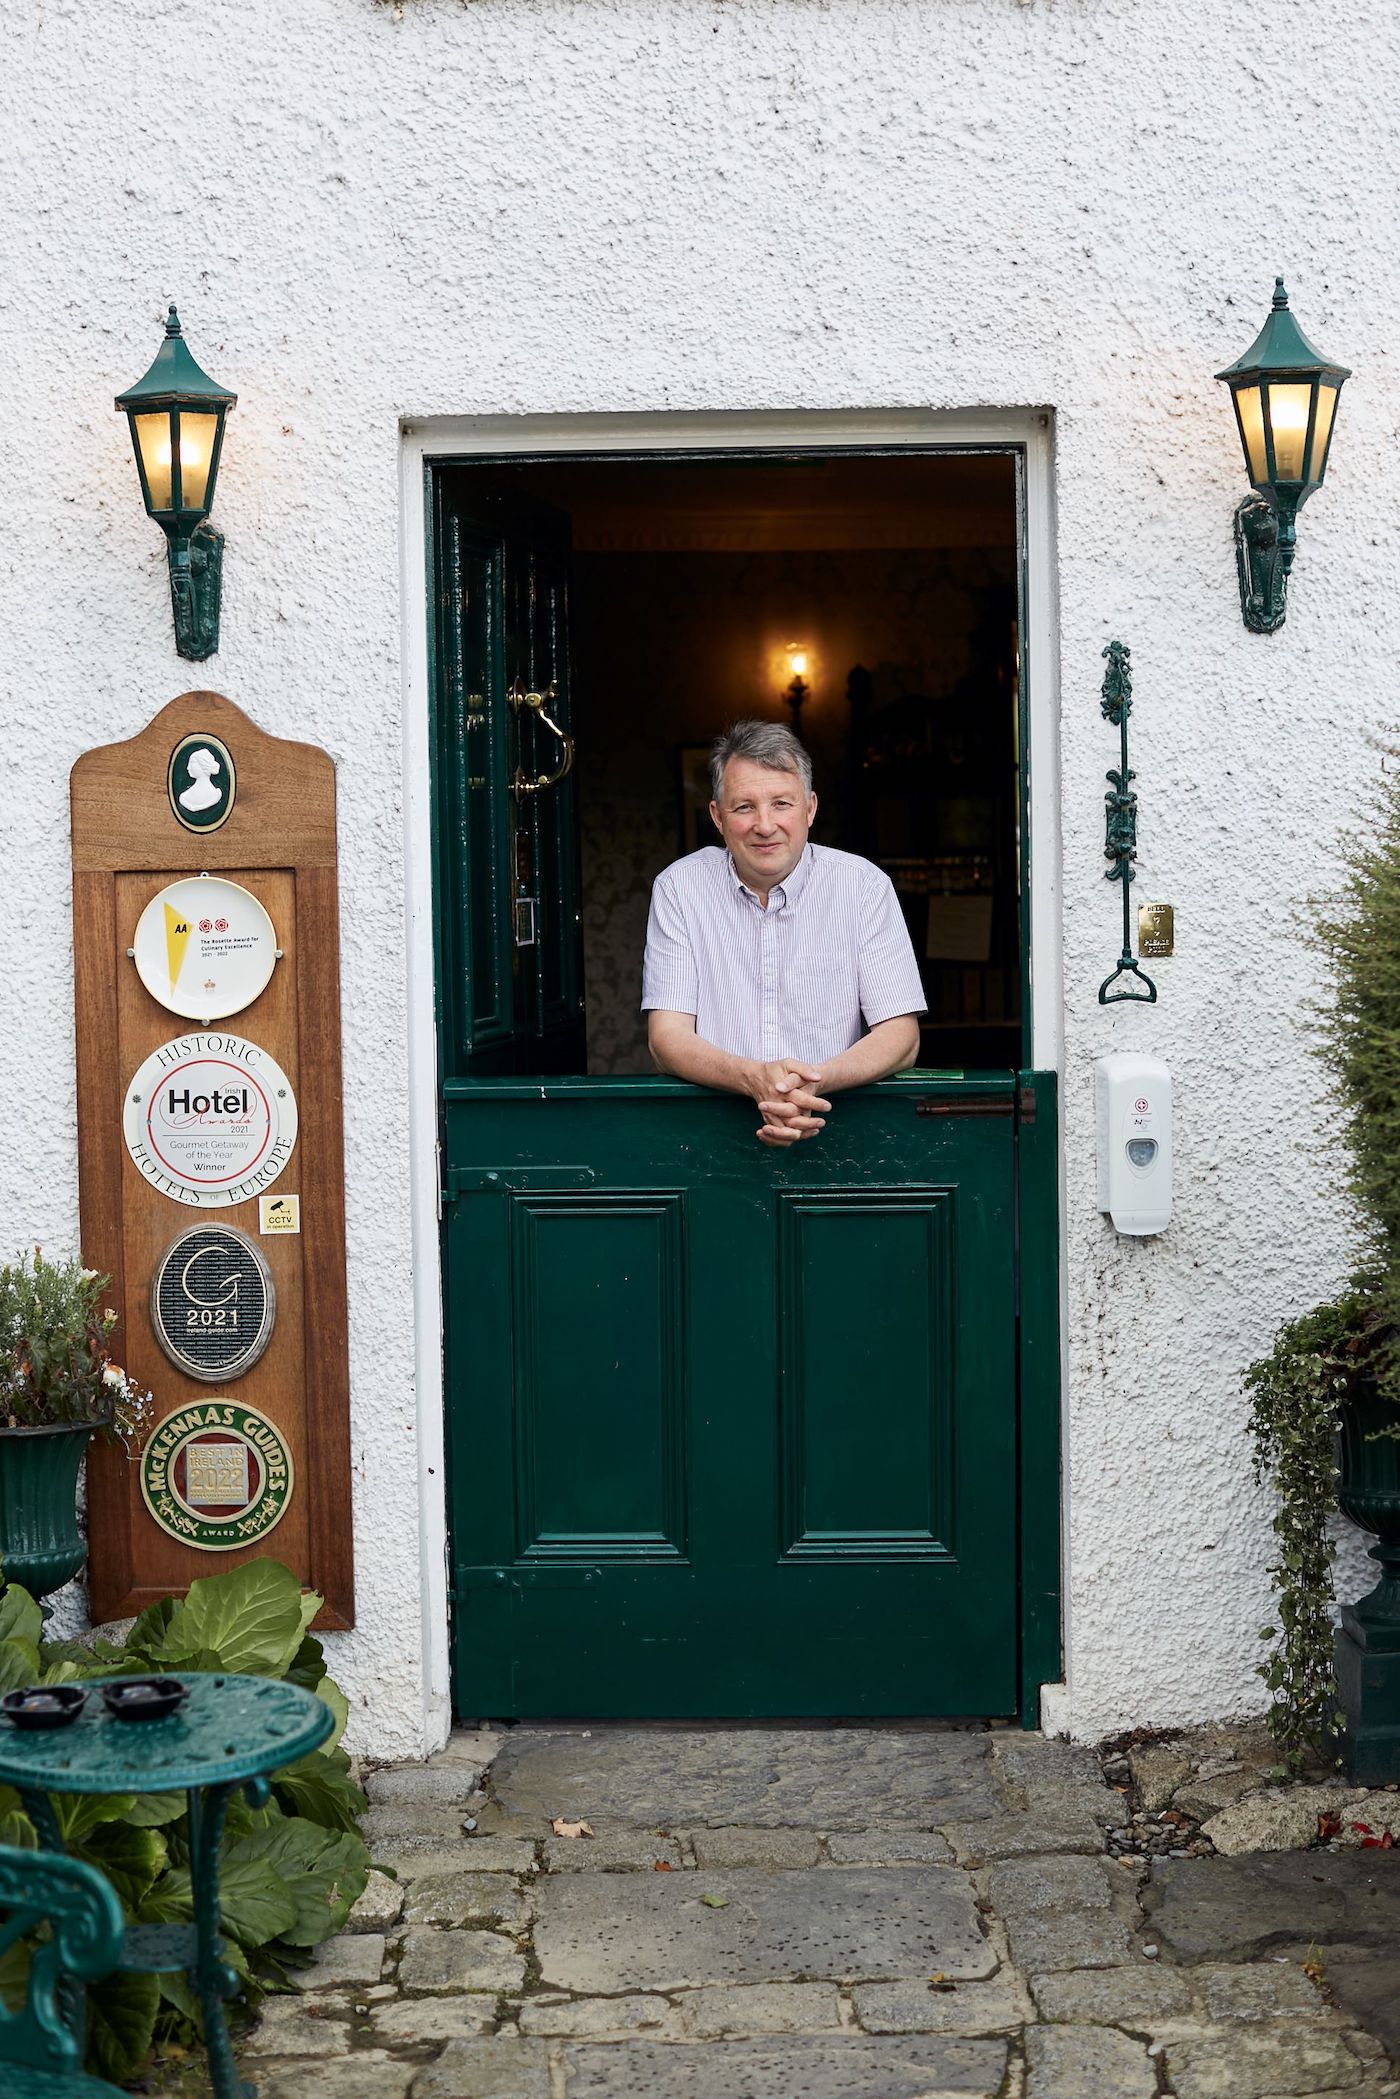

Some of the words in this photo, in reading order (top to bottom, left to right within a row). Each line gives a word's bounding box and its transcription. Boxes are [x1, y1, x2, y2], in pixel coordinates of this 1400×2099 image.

[174, 923, 188, 934] AA
[156, 1035, 262, 1068] HISTORIC
[169, 1088, 248, 1114] Hotel
[173, 1101, 254, 1125] Awards
[230, 1125, 249, 1134] 2021
[169, 1140, 209, 1150] Gourmet
[212, 1140, 249, 1151] Getaway
[185, 1150, 194, 1159] of
[195, 1151, 211, 1160] the
[213, 1150, 233, 1160] Year
[131, 1143, 201, 1204] HOTELS
[228, 1136, 294, 1202] EUROPE
[193, 1163, 227, 1172] Winner
[268, 1216, 293, 1224] CCTV
[186, 1309, 238, 1326] 2021
[189, 1447, 225, 1458] BEST
[228, 1447, 244, 1457] IN
[242, 1417, 287, 1492] GUIDES
[189, 1457, 244, 1468] IRELAND
[190, 1467, 244, 1490] 2022
